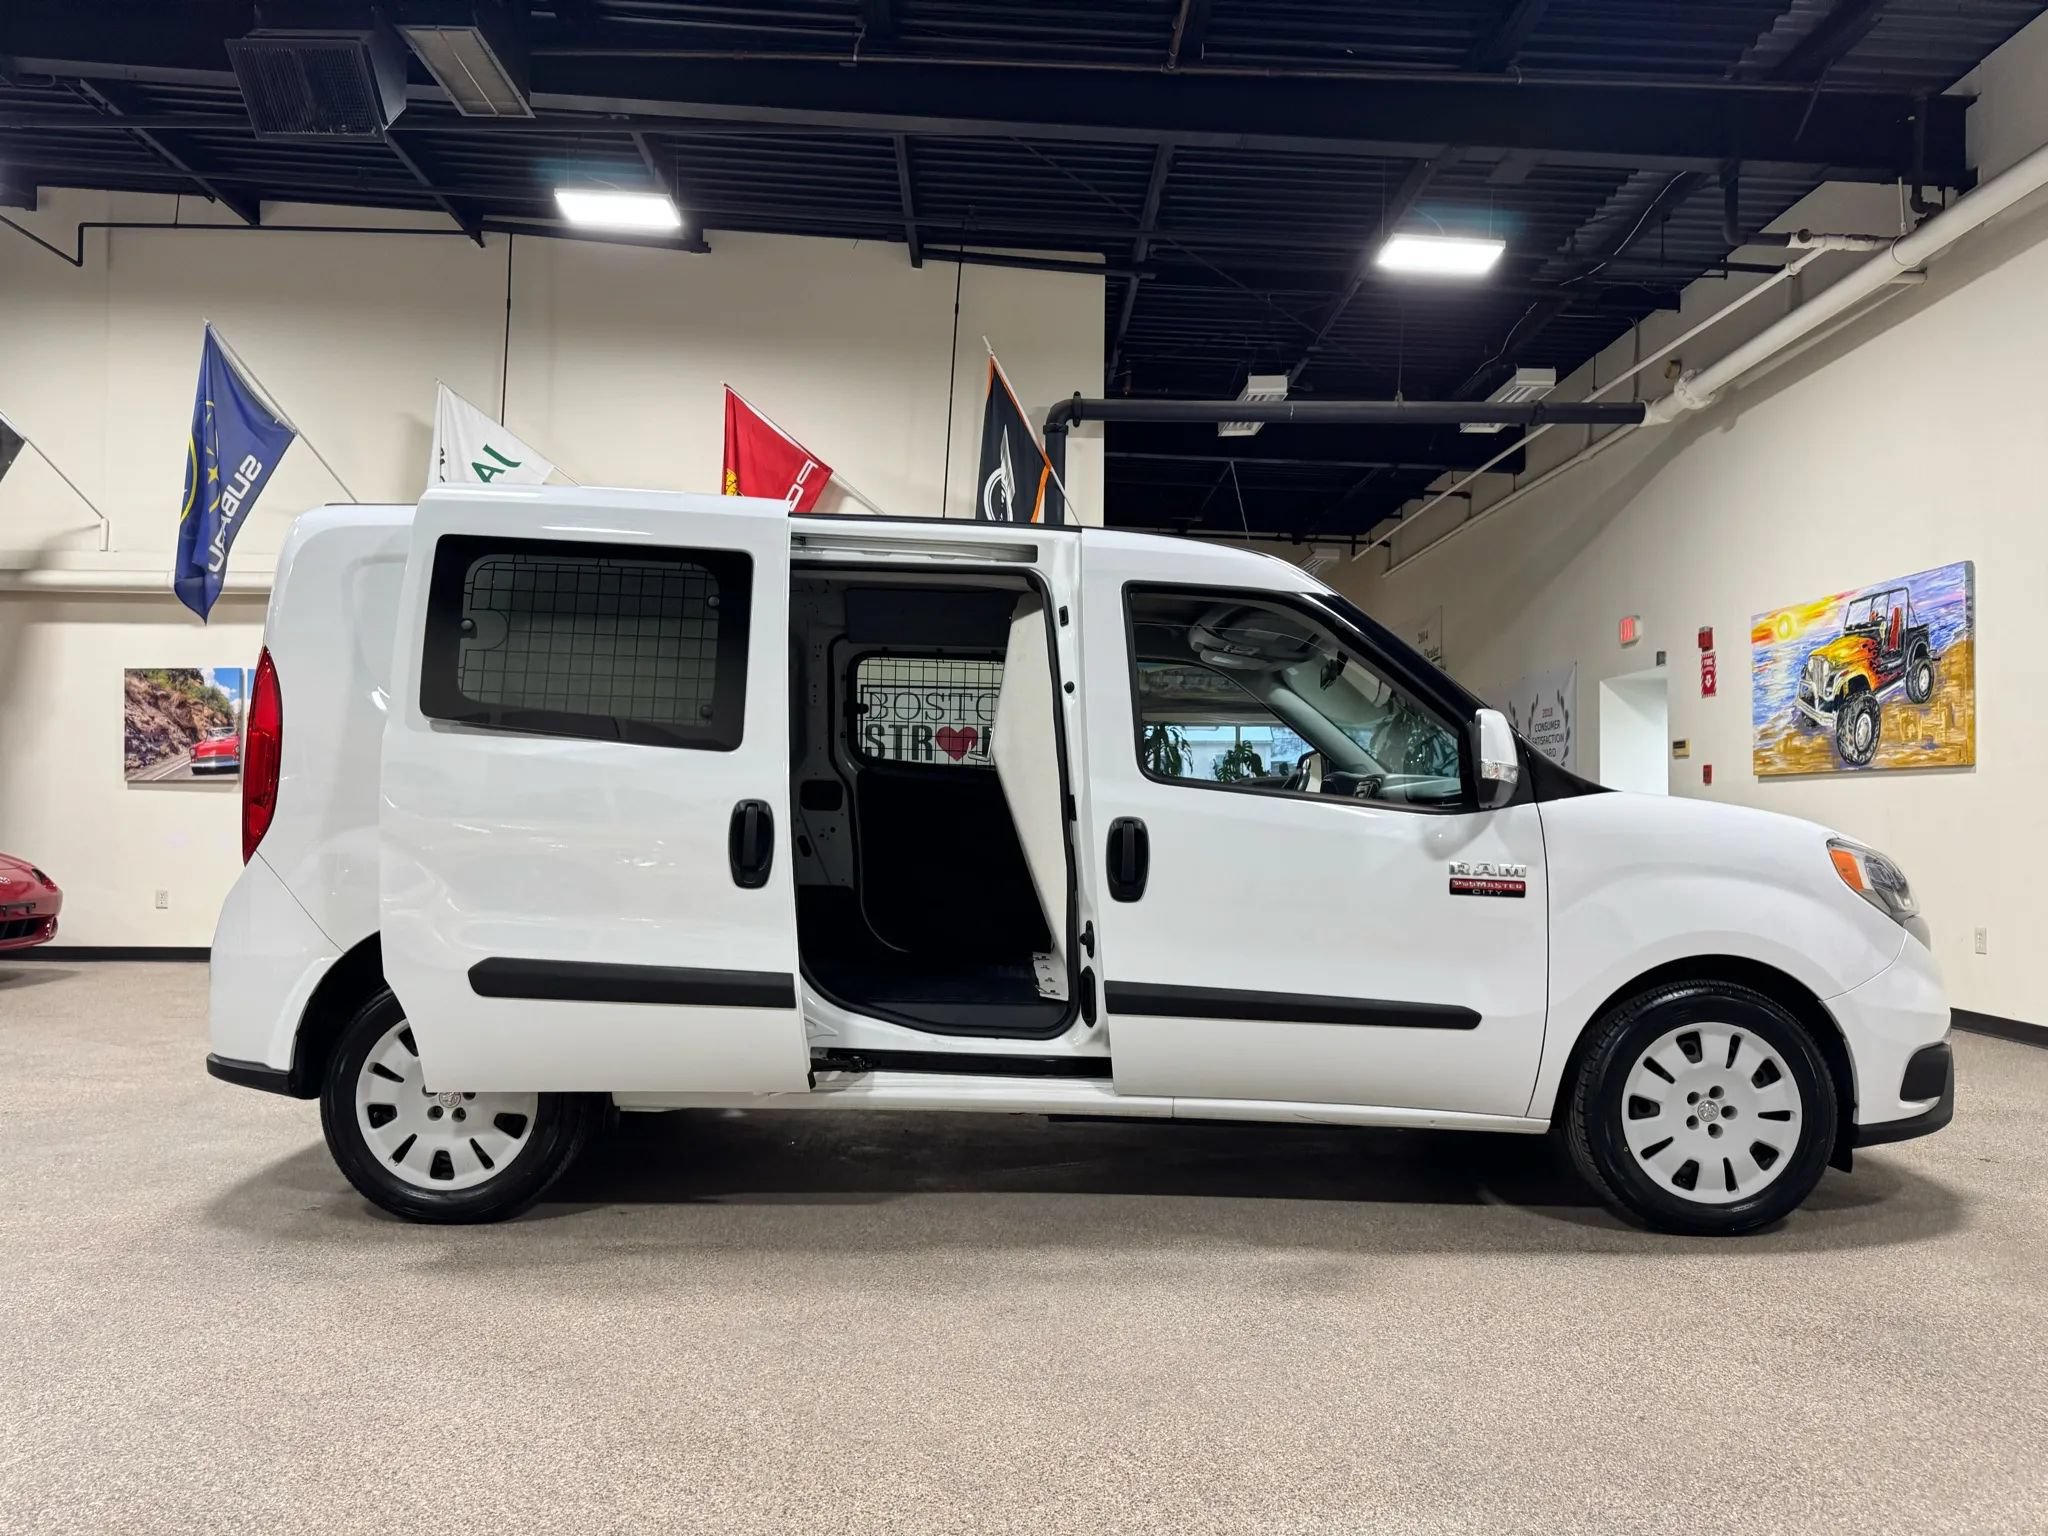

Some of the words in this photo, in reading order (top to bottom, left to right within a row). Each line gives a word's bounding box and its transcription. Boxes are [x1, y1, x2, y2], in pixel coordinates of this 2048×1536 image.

[866, 692, 999, 721] BOSTO
[1534, 719, 1560, 732] CONSUMER
[1449, 861, 1526, 877] RAM
